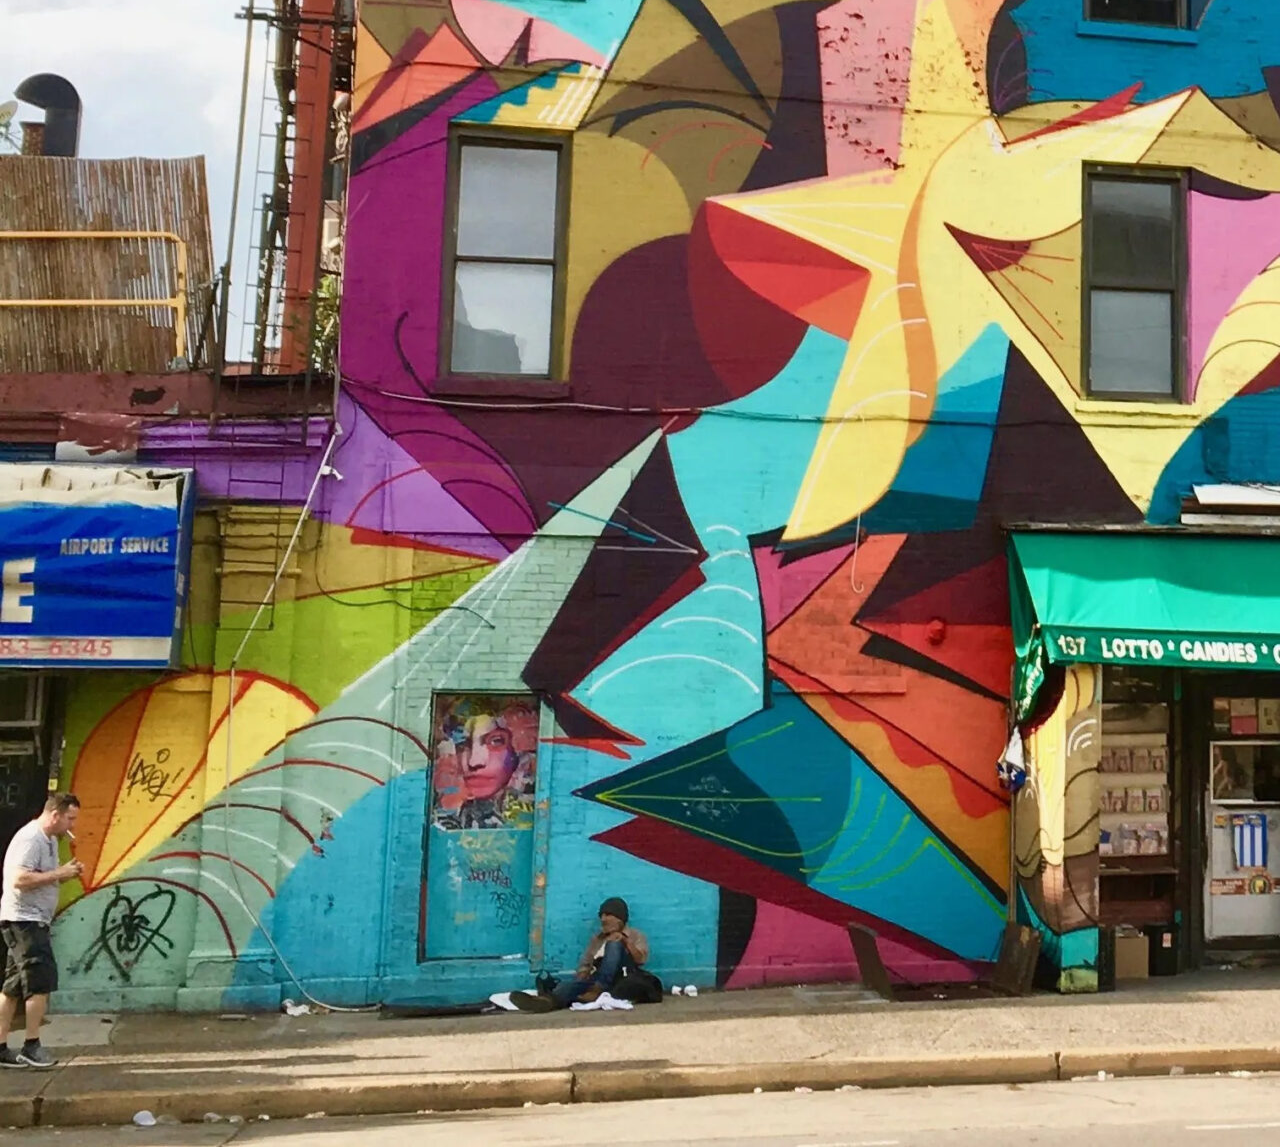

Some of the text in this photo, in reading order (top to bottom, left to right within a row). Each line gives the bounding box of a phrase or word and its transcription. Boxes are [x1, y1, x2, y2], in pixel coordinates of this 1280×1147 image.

[60, 537, 169, 556] AIRPORT SERVICE
[1057, 635, 1086, 655] 137
[1101, 637, 1164, 659] LOTTO
[1180, 640, 1257, 663] CANDIES
